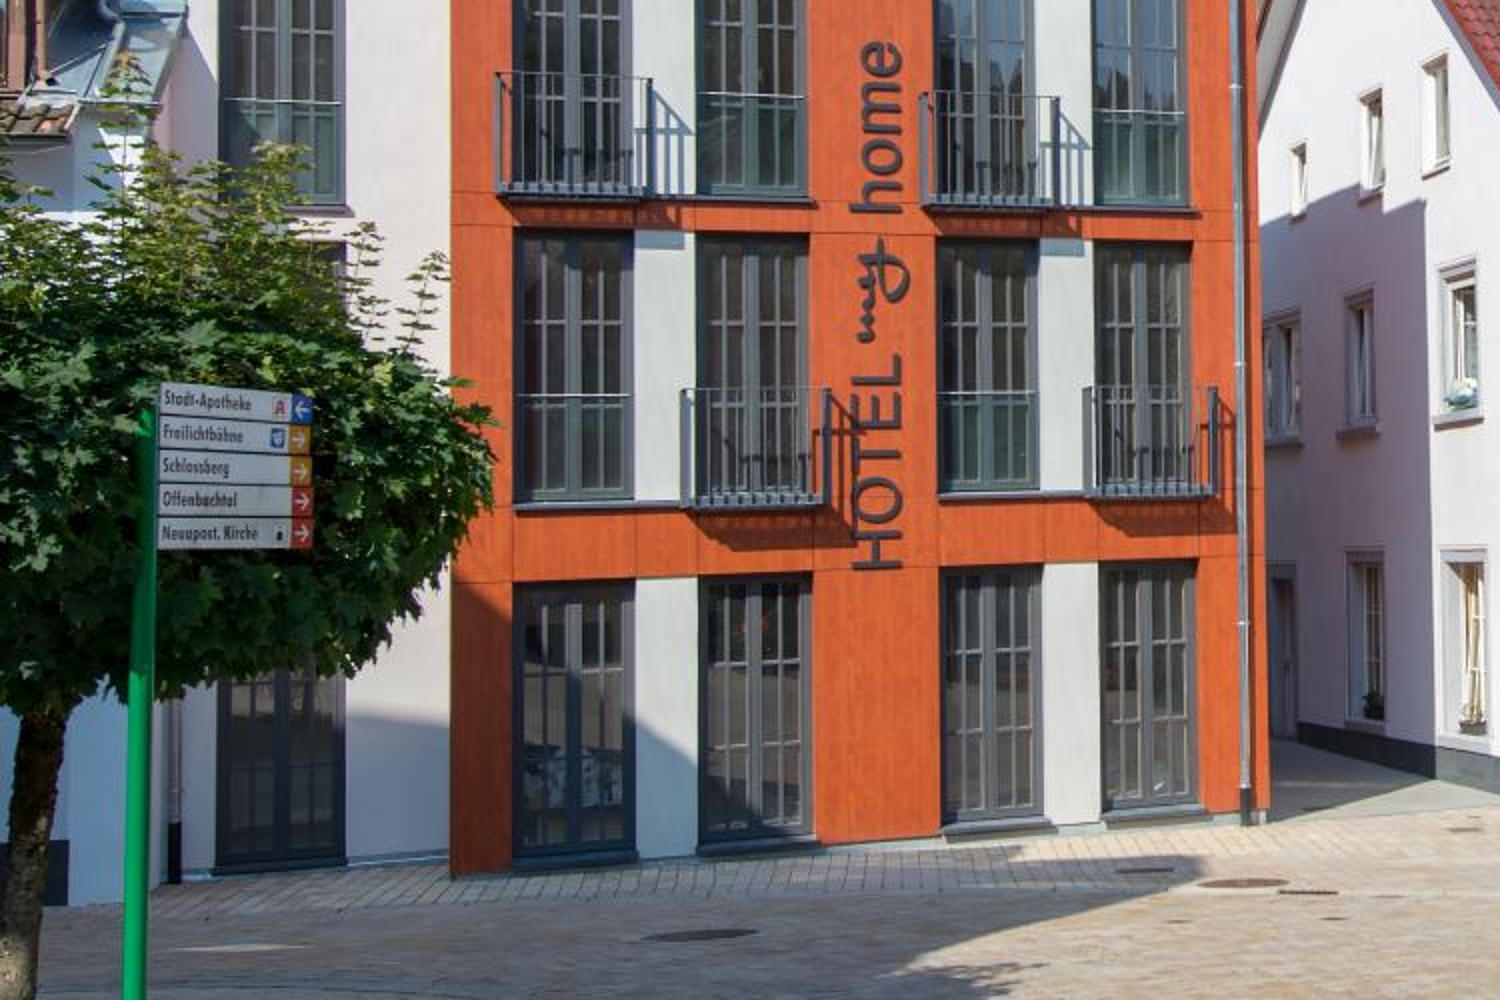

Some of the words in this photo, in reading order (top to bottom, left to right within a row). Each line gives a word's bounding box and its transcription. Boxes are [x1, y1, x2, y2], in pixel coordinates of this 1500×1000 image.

[848, 39, 904, 214] home
[854, 235, 912, 344] my
[164, 389, 253, 412] Stadt-Apotheke
[162, 423, 244, 443] Freilichtbühne
[162, 457, 231, 479] Schlossberg
[850, 353, 902, 571] HOTEL
[162, 490, 238, 508] Offenbachtal
[223, 524, 259, 541] Kirche
